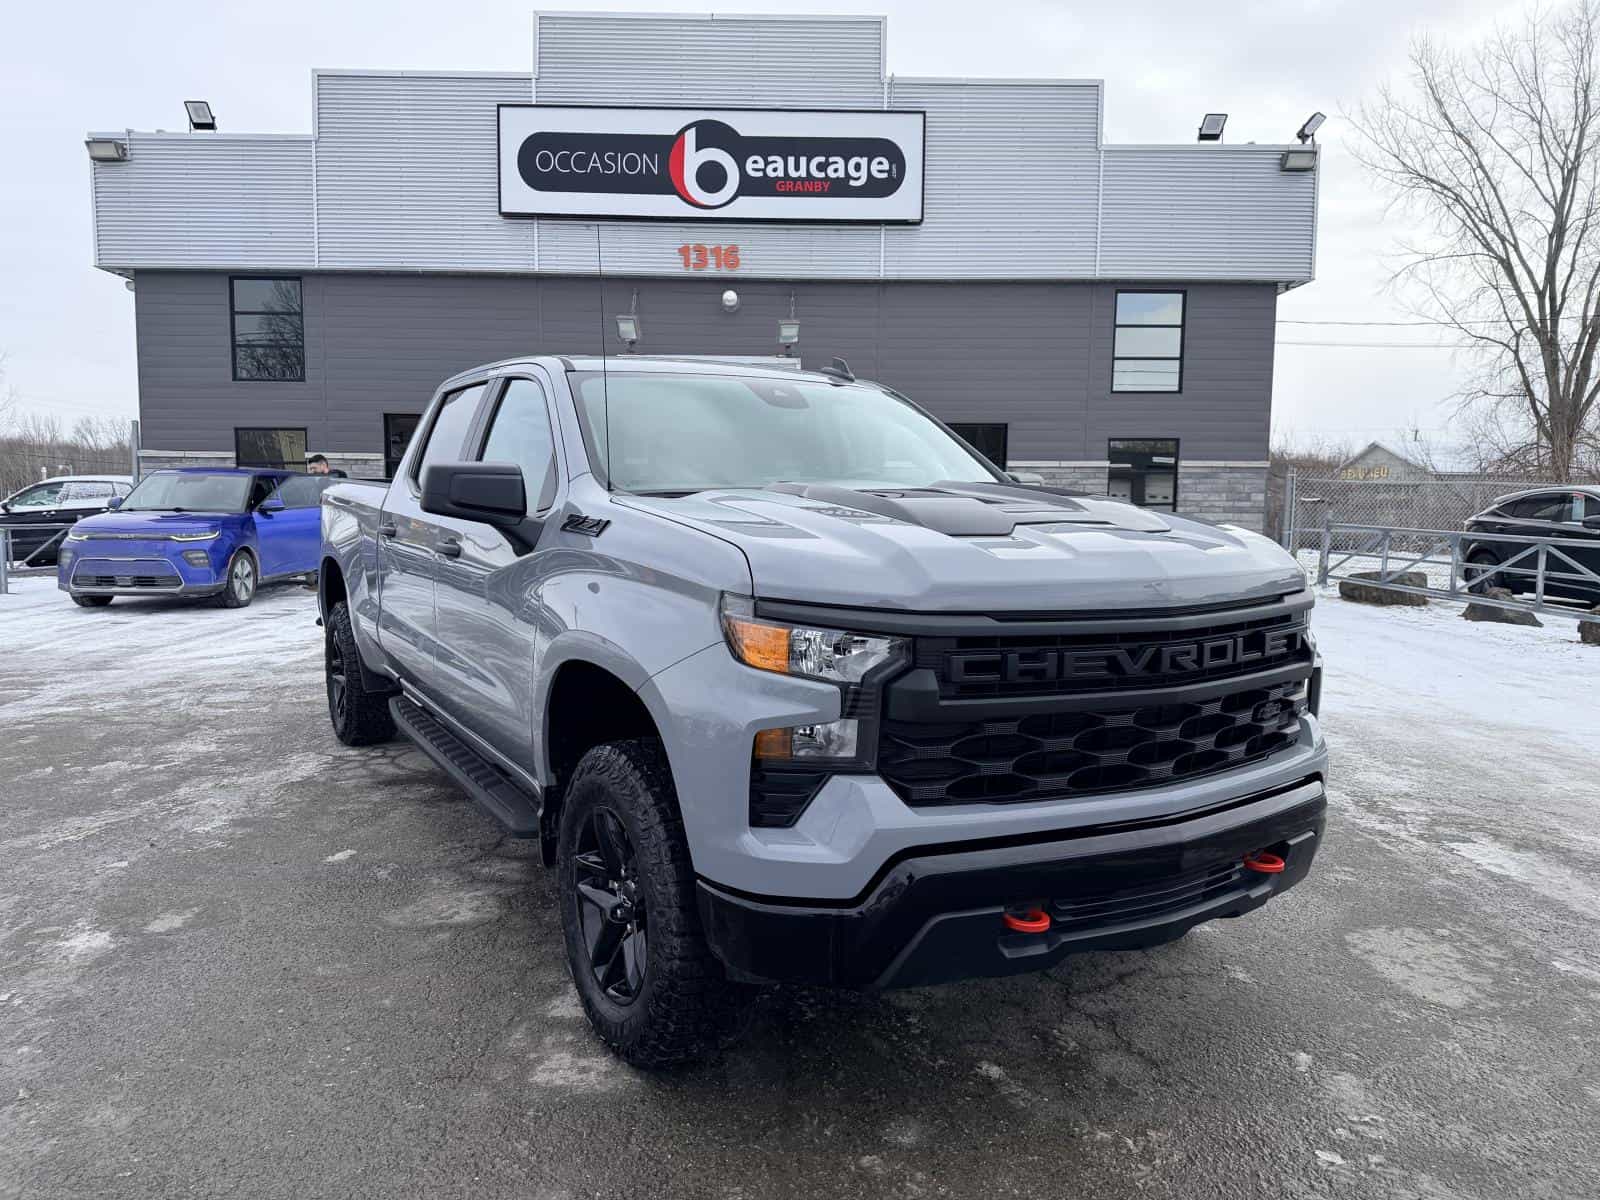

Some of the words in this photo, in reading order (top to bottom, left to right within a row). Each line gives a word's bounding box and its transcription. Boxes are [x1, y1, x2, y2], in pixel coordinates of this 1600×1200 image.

[535, 150, 659, 176] OCCASION
[776, 180, 831, 193] GRANBY
[677, 243, 740, 271] 1316
